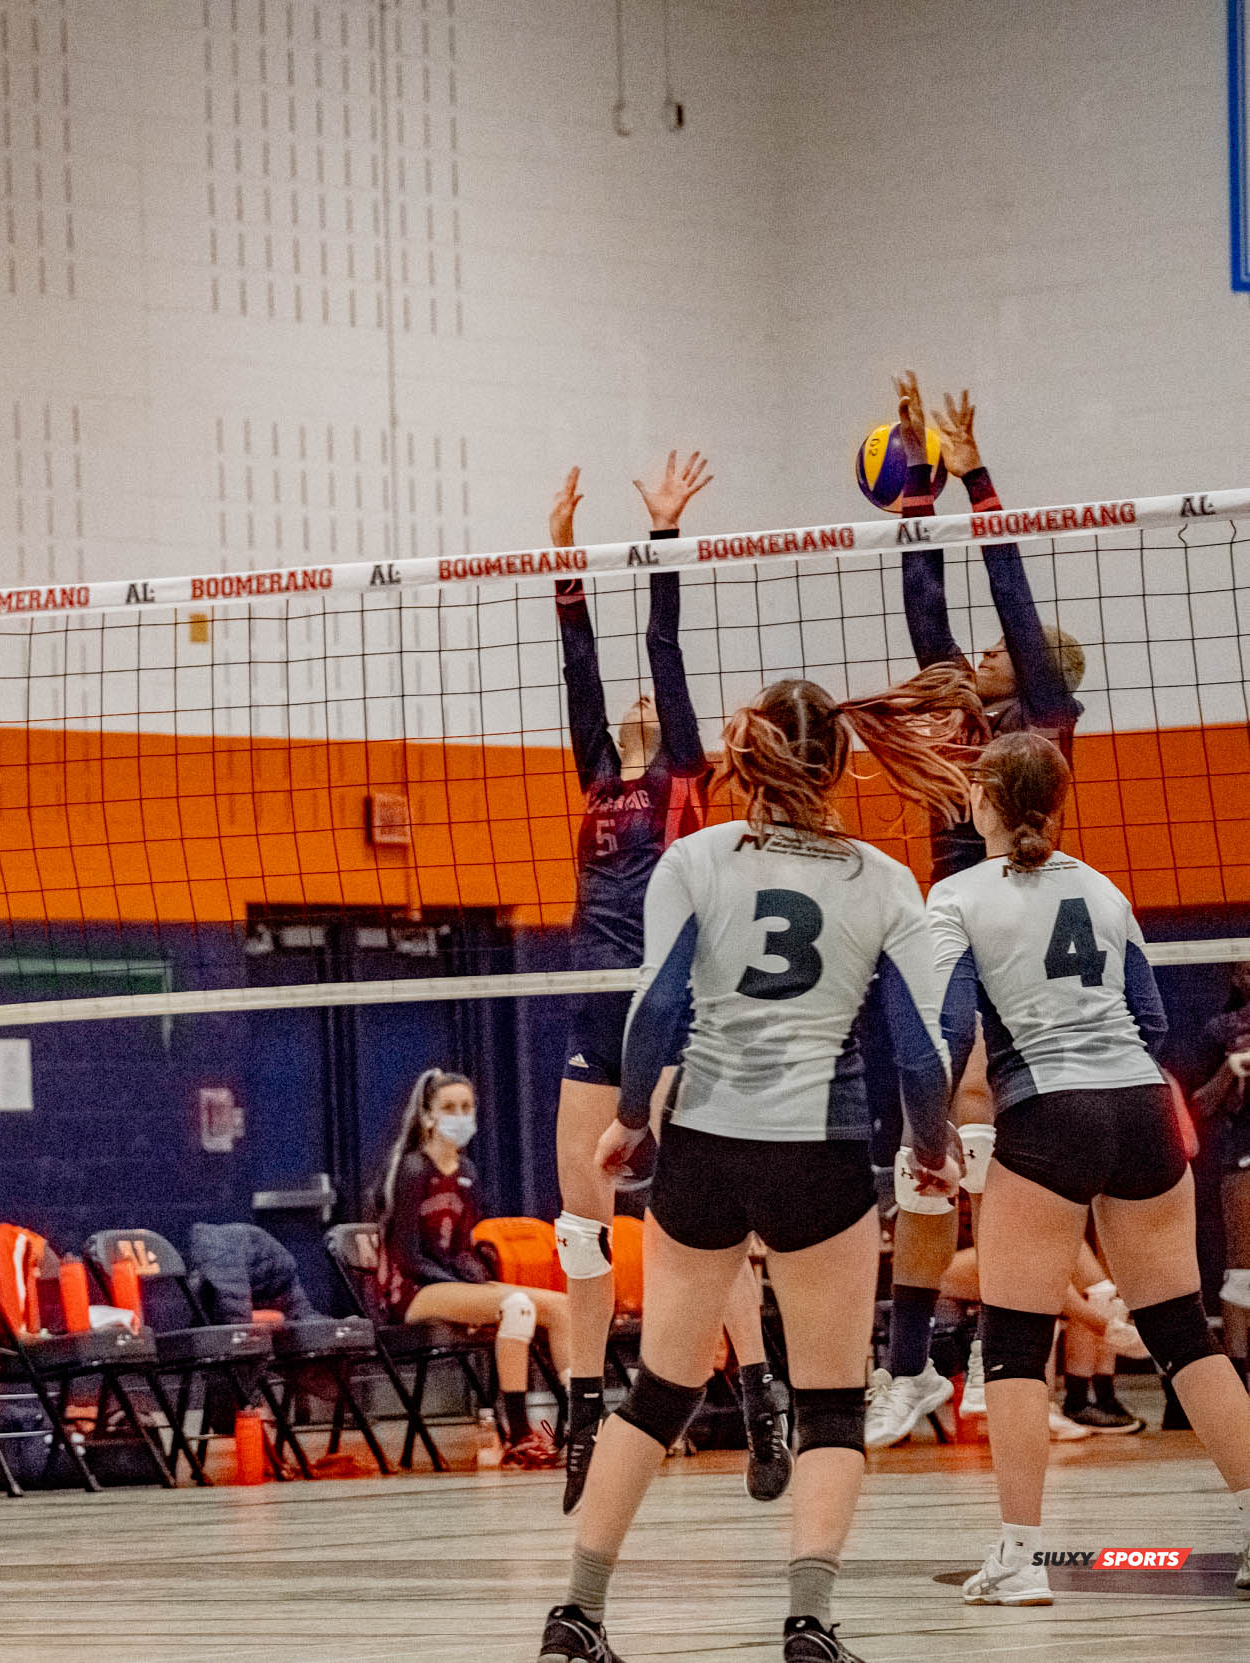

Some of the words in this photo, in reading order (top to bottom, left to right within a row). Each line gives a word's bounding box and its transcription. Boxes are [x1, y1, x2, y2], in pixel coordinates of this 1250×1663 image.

[190, 568, 333, 601] BOOMERANG
[438, 549, 588, 582] BOOMERANG
[696, 526, 855, 562] BOOMERANG
[971, 502, 1137, 539] BOOMERANG
[596, 819, 618, 857] 5
[735, 888, 824, 1001] 3
[1044, 897, 1107, 987] 4
